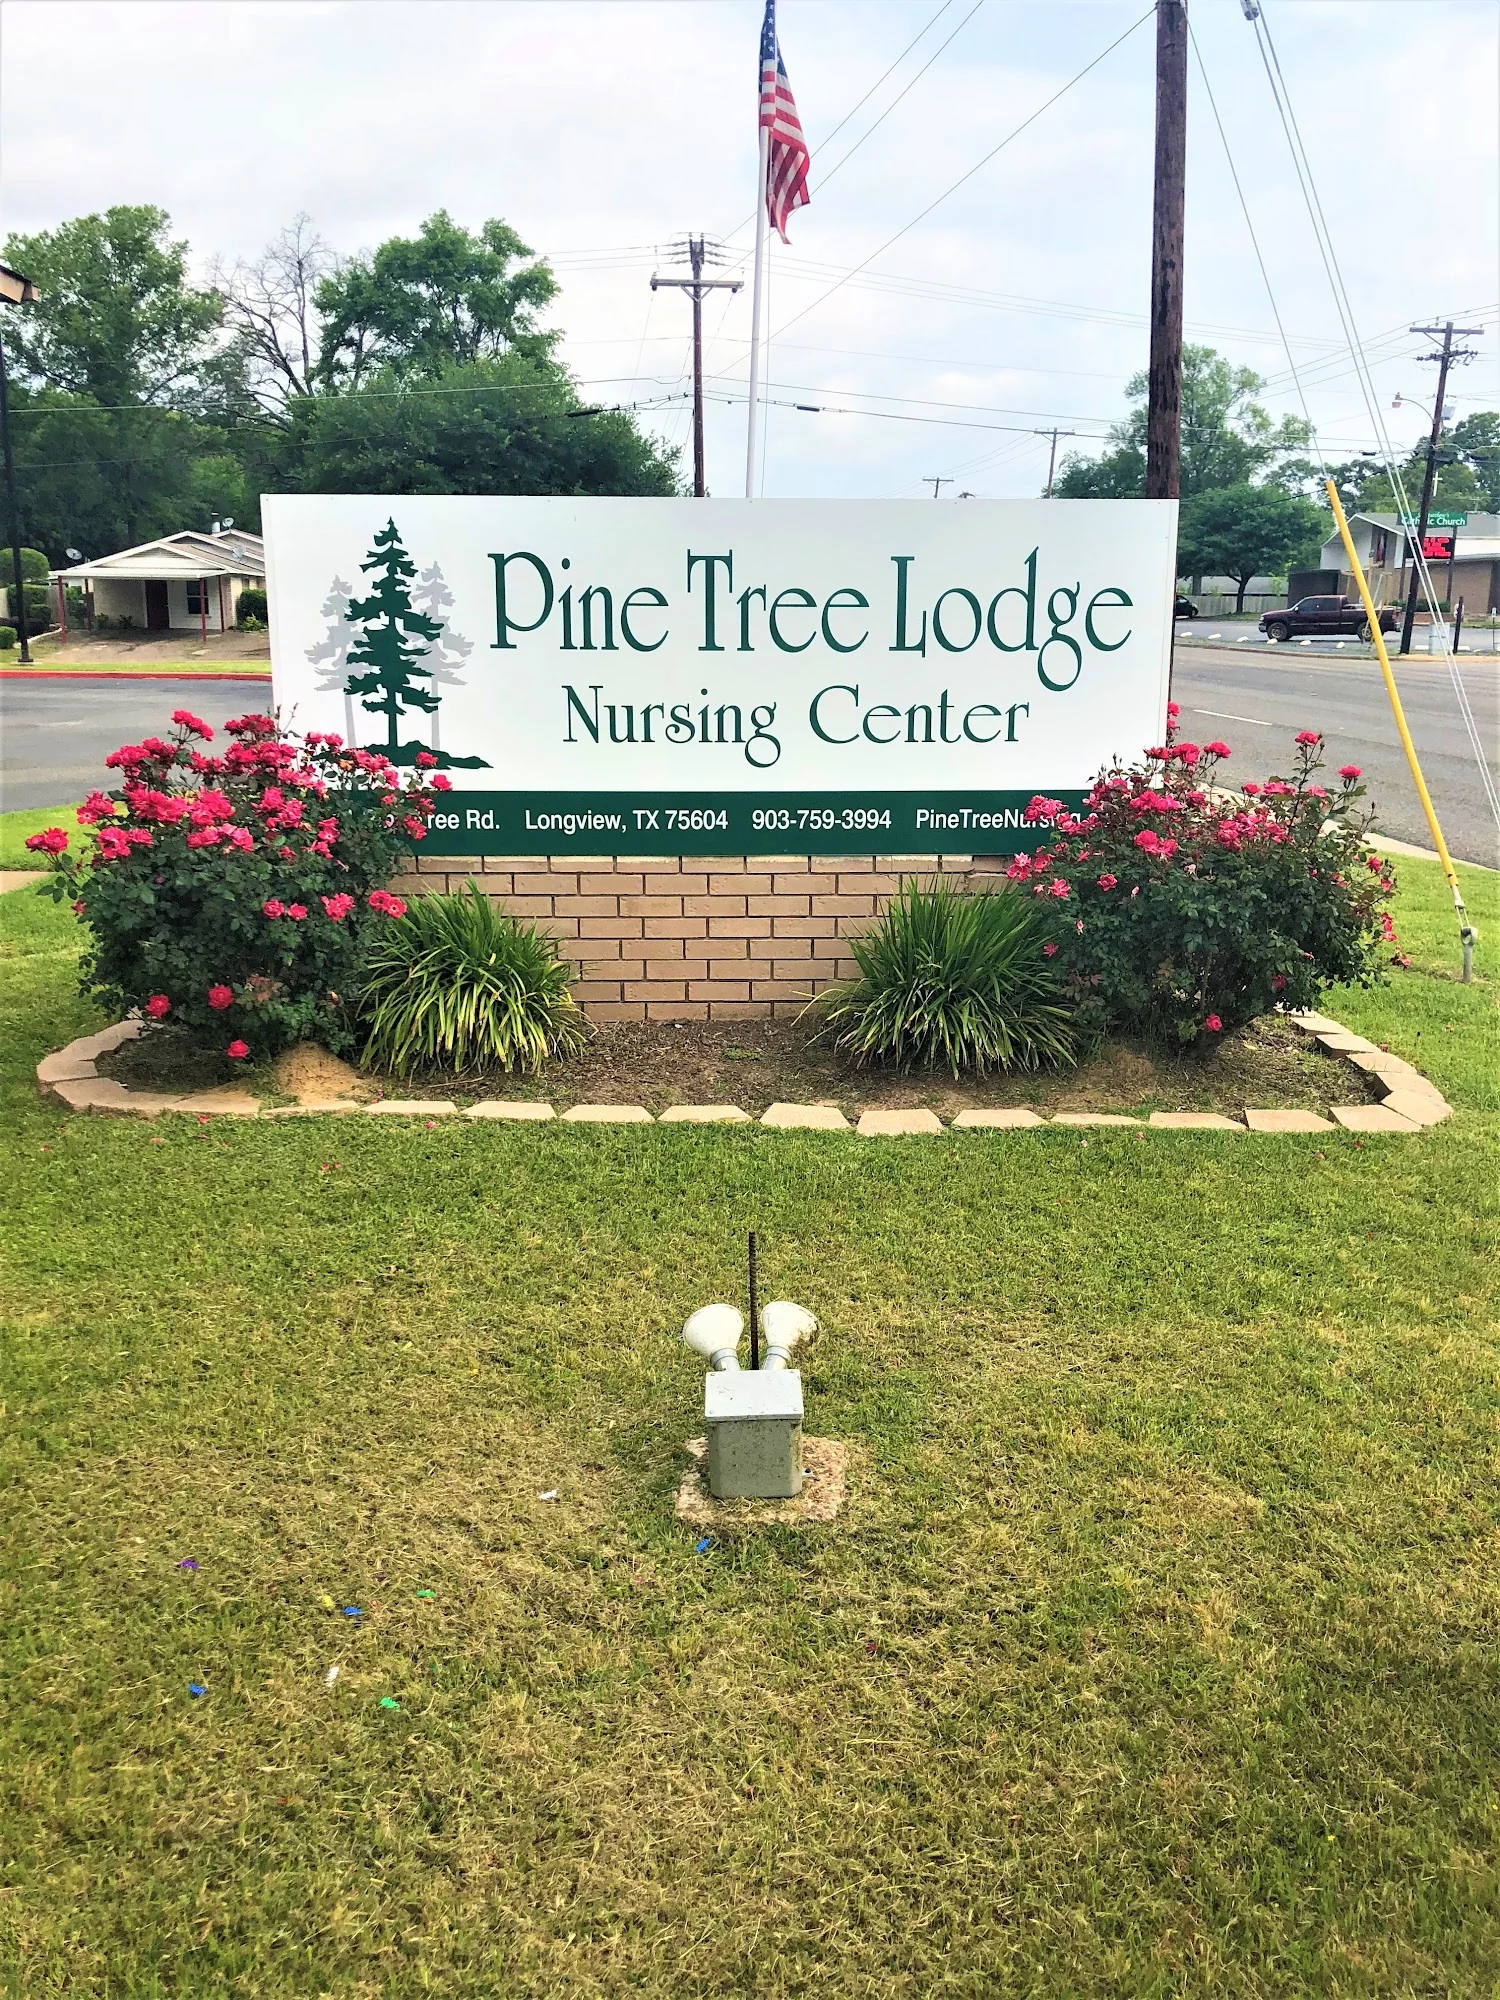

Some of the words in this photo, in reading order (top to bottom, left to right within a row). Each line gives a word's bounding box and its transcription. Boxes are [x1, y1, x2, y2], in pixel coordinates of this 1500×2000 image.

[1437, 516, 1466, 526] Church
[487, 551, 670, 654] Pine
[686, 548, 870, 654] Tree
[888, 545, 1134, 692] Lodge
[561, 685, 782, 769] Nursing
[809, 684, 1030, 745] Center
[416, 809, 460, 830] ree
[466, 809, 500, 830] Rd.
[525, 809, 627, 835] Longview,
[632, 809, 660, 830] TX
[664, 809, 729, 830] 75604
[751, 808, 892, 830] 903-759-3994
